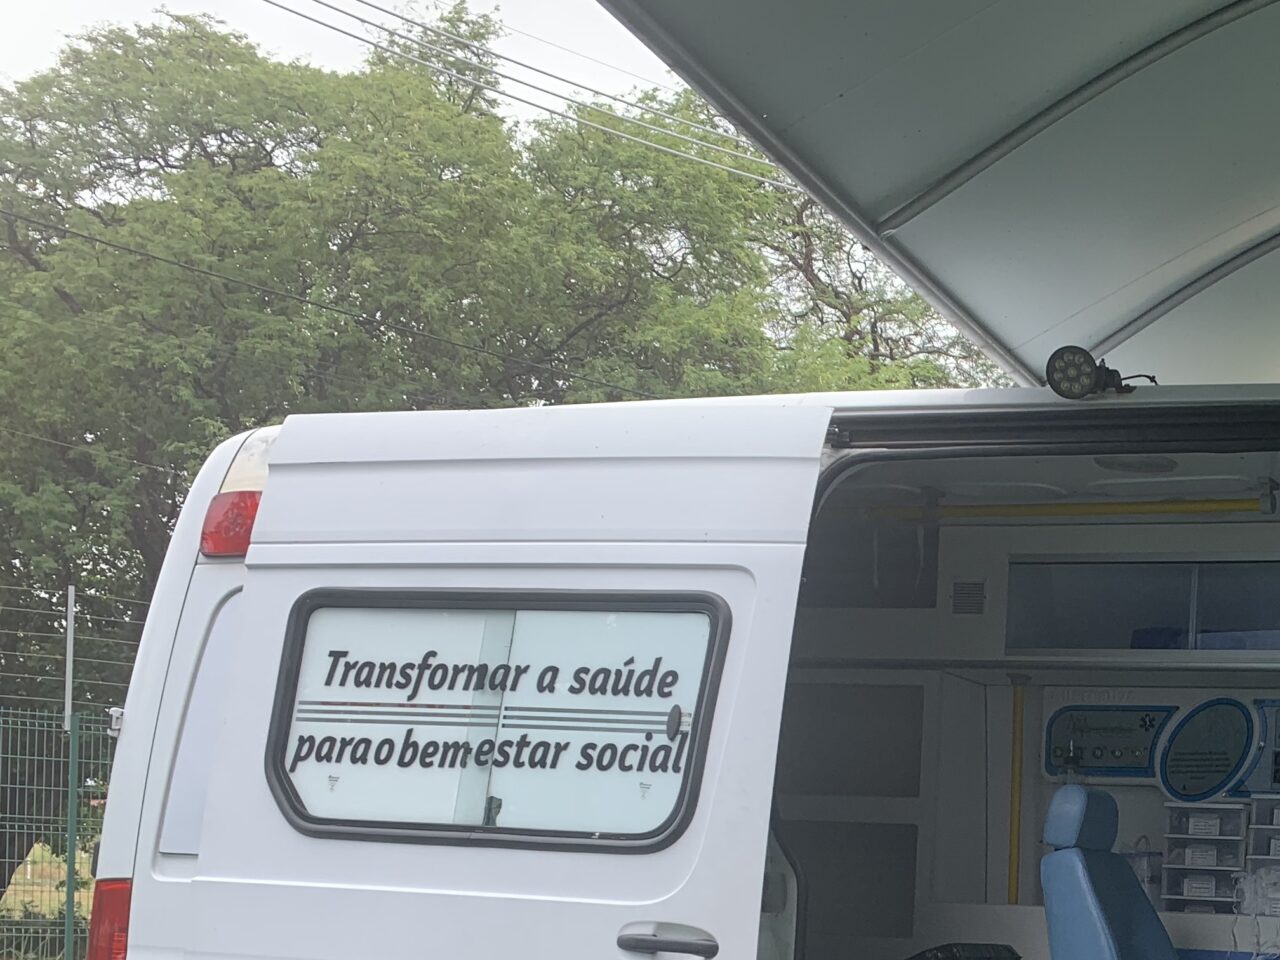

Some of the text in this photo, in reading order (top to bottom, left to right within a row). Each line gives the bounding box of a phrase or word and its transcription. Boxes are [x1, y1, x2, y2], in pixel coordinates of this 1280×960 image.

[536, 665, 560, 694] a
[568, 656, 679, 698] saúde
[575, 731, 688, 774] social
